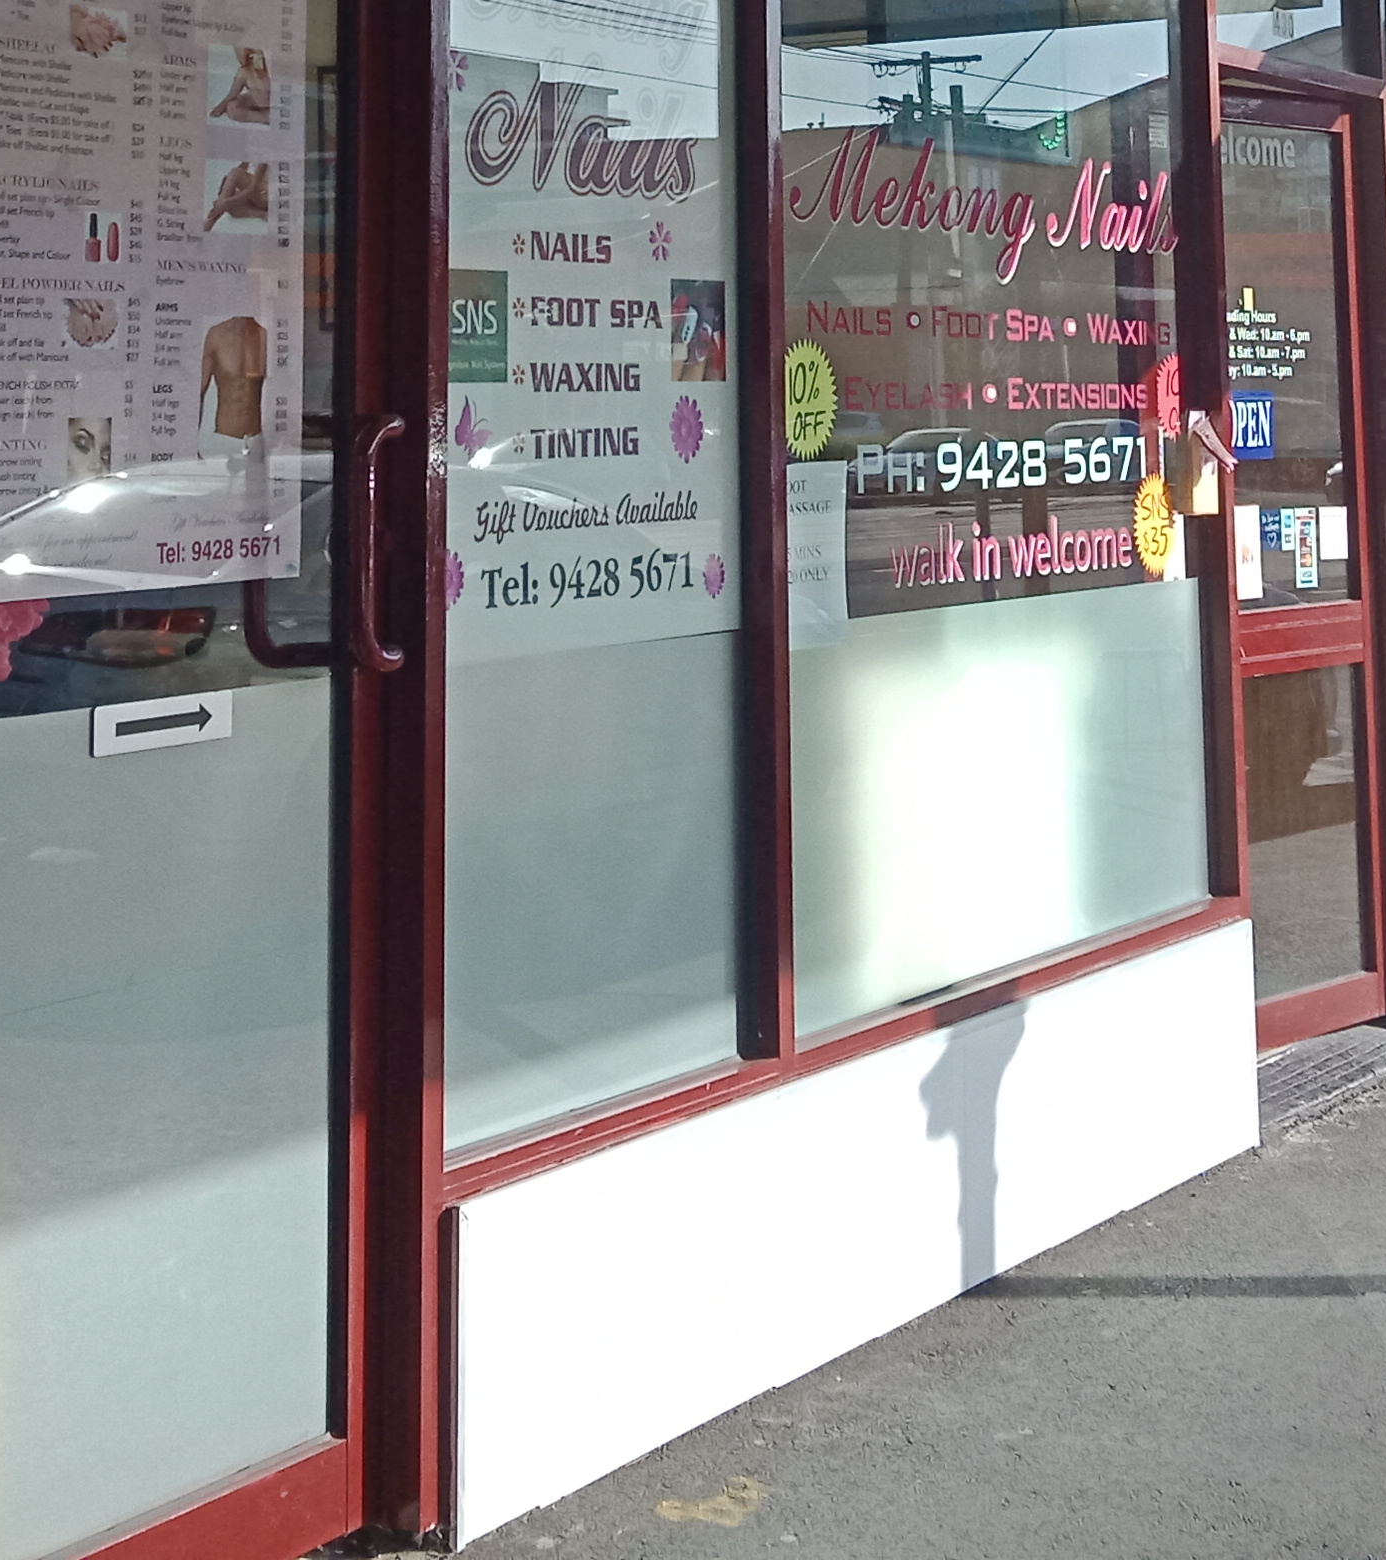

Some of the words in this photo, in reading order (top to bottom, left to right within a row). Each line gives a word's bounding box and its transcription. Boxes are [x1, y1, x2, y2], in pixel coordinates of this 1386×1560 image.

[1221, 125, 1295, 170] elcome
[789, 124, 1036, 285] Mekong
[1046, 157, 1179, 256] Nails
[531, 231, 612, 264] NAILS
[22, 277, 82, 291] POWDER
[84, 280, 126, 292] NAILS
[155, 303, 179, 313] ARMS
[452, 300, 498, 335] SNS
[530, 296, 601, 328] FOOT
[611, 299, 663, 329] SPA
[1251, 309, 1277, 324] Hours
[152, 384, 173, 394] LEGS
[530, 362, 641, 393] WAXING
[789, 360, 820, 406] 10%
[793, 410, 827, 442] OFF
[151, 452, 174, 462] BODY
[532, 427, 640, 459] TINTING
[937, 438, 1047, 494] 9428
[1065, 435, 1148, 485] 5671
[474, 500, 516, 544] Gift
[522, 497, 609, 533] Vouchers
[615, 490, 698, 524] Available
[156, 542, 185, 565] Tel:
[192, 538, 233, 562] 9428
[239, 535, 280, 558] 5671
[890, 522, 966, 589] walk
[972, 523, 1002, 582] in
[1013, 513, 1133, 579] welcome
[1143, 526, 1169, 557] $35
[481, 565, 538, 609] Tel:
[549, 556, 619, 608] 9428
[630, 551, 694, 596] 5671
